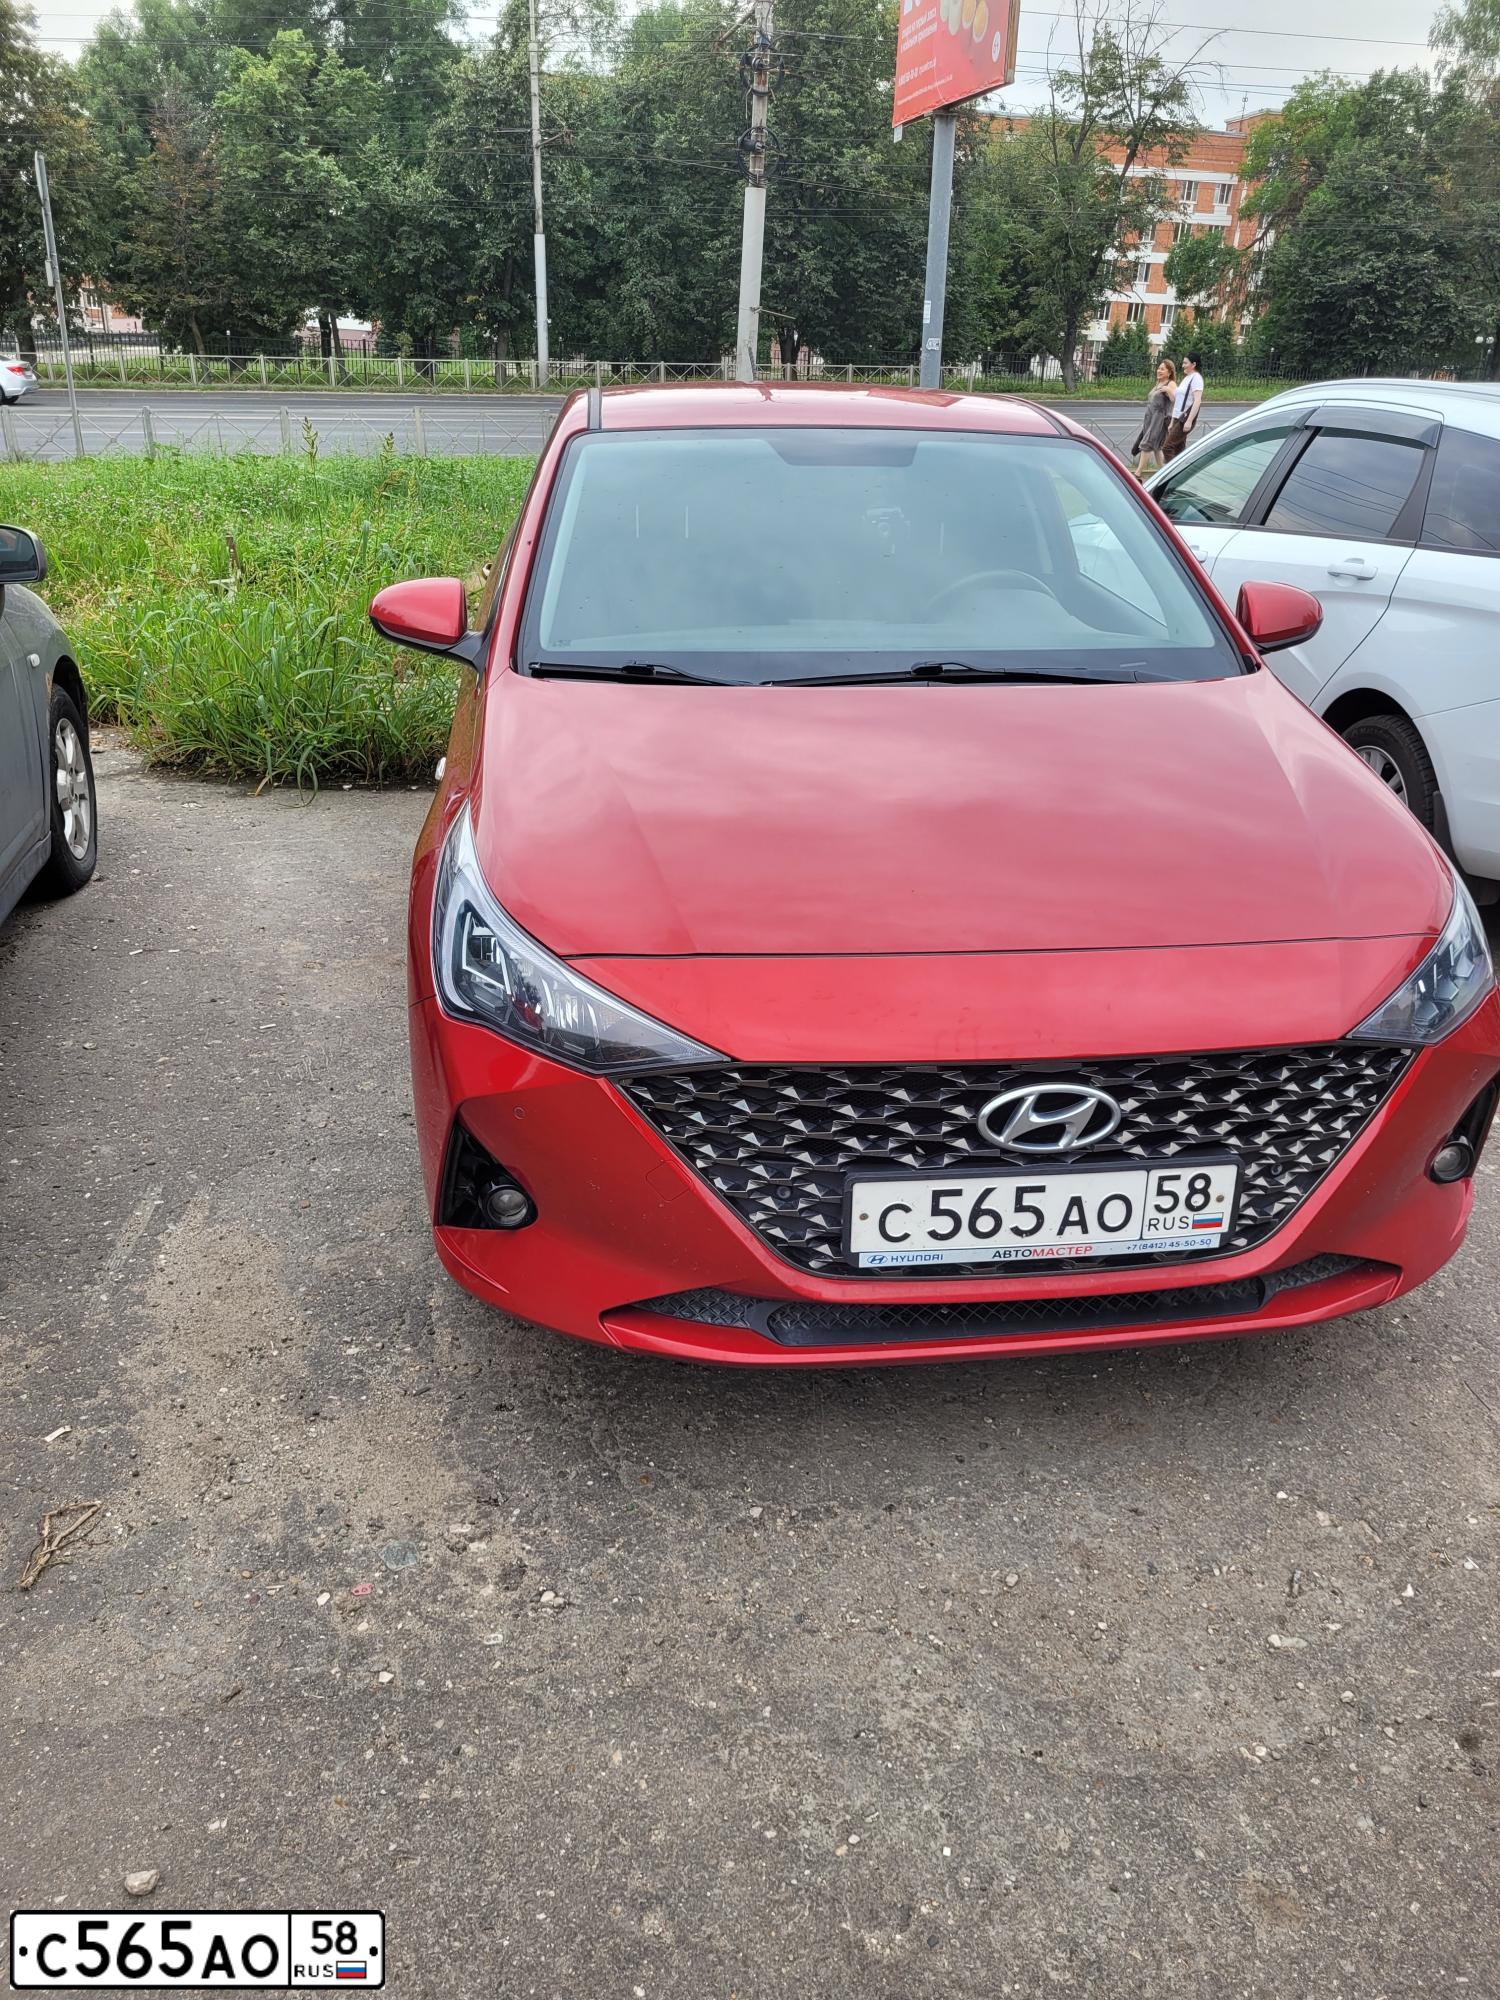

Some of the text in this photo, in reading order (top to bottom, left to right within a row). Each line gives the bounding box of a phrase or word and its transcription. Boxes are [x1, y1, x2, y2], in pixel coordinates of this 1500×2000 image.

[1154, 1172, 1211, 1214] 58
[878, 1185, 1133, 1243] С565АО
[1147, 1216, 1189, 1232] RUS
[1168, 1238, 1212, 1248] 45-50-50
[890, 1254, 944, 1263] HYUNDAI
[992, 1245, 1093, 1260] АВТОМАСТЕР
